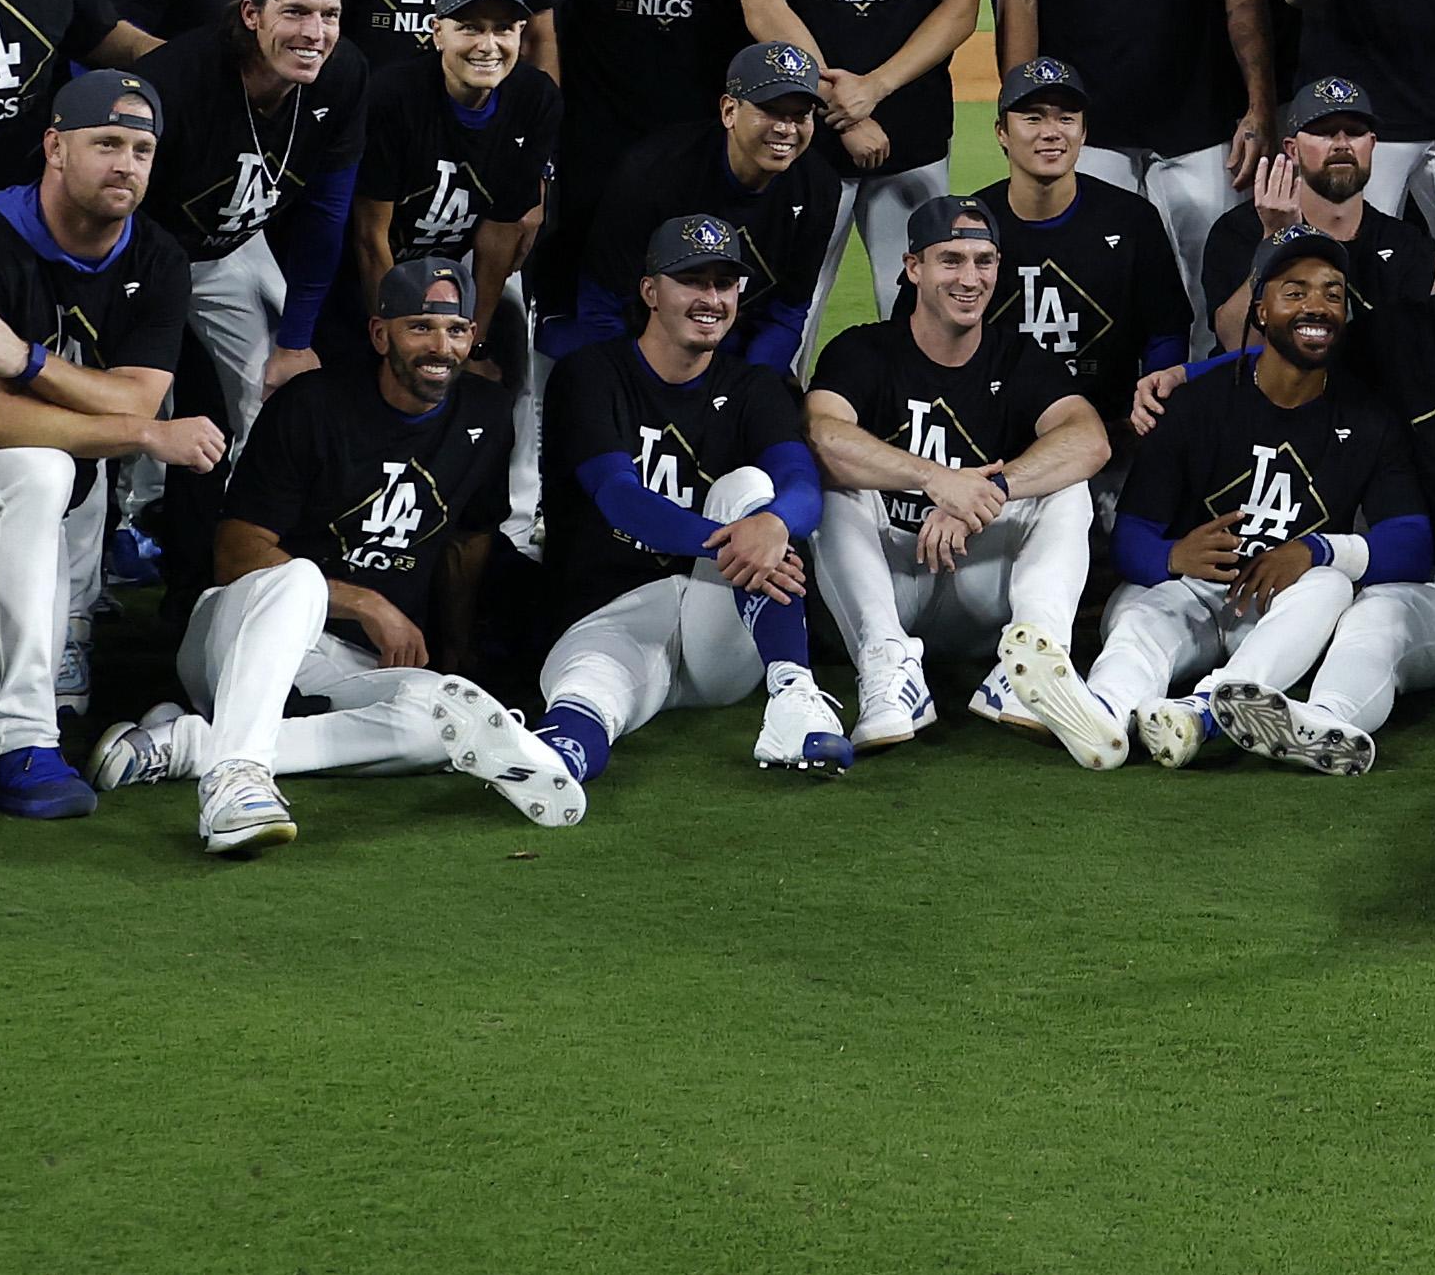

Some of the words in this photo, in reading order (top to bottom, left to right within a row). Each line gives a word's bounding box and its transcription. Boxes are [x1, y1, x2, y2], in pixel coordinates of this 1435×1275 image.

[413, 160, 481, 243] LA
[1018, 265, 1079, 352] LA
[360, 462, 422, 548] LA
[1239, 445, 1304, 541] LA
